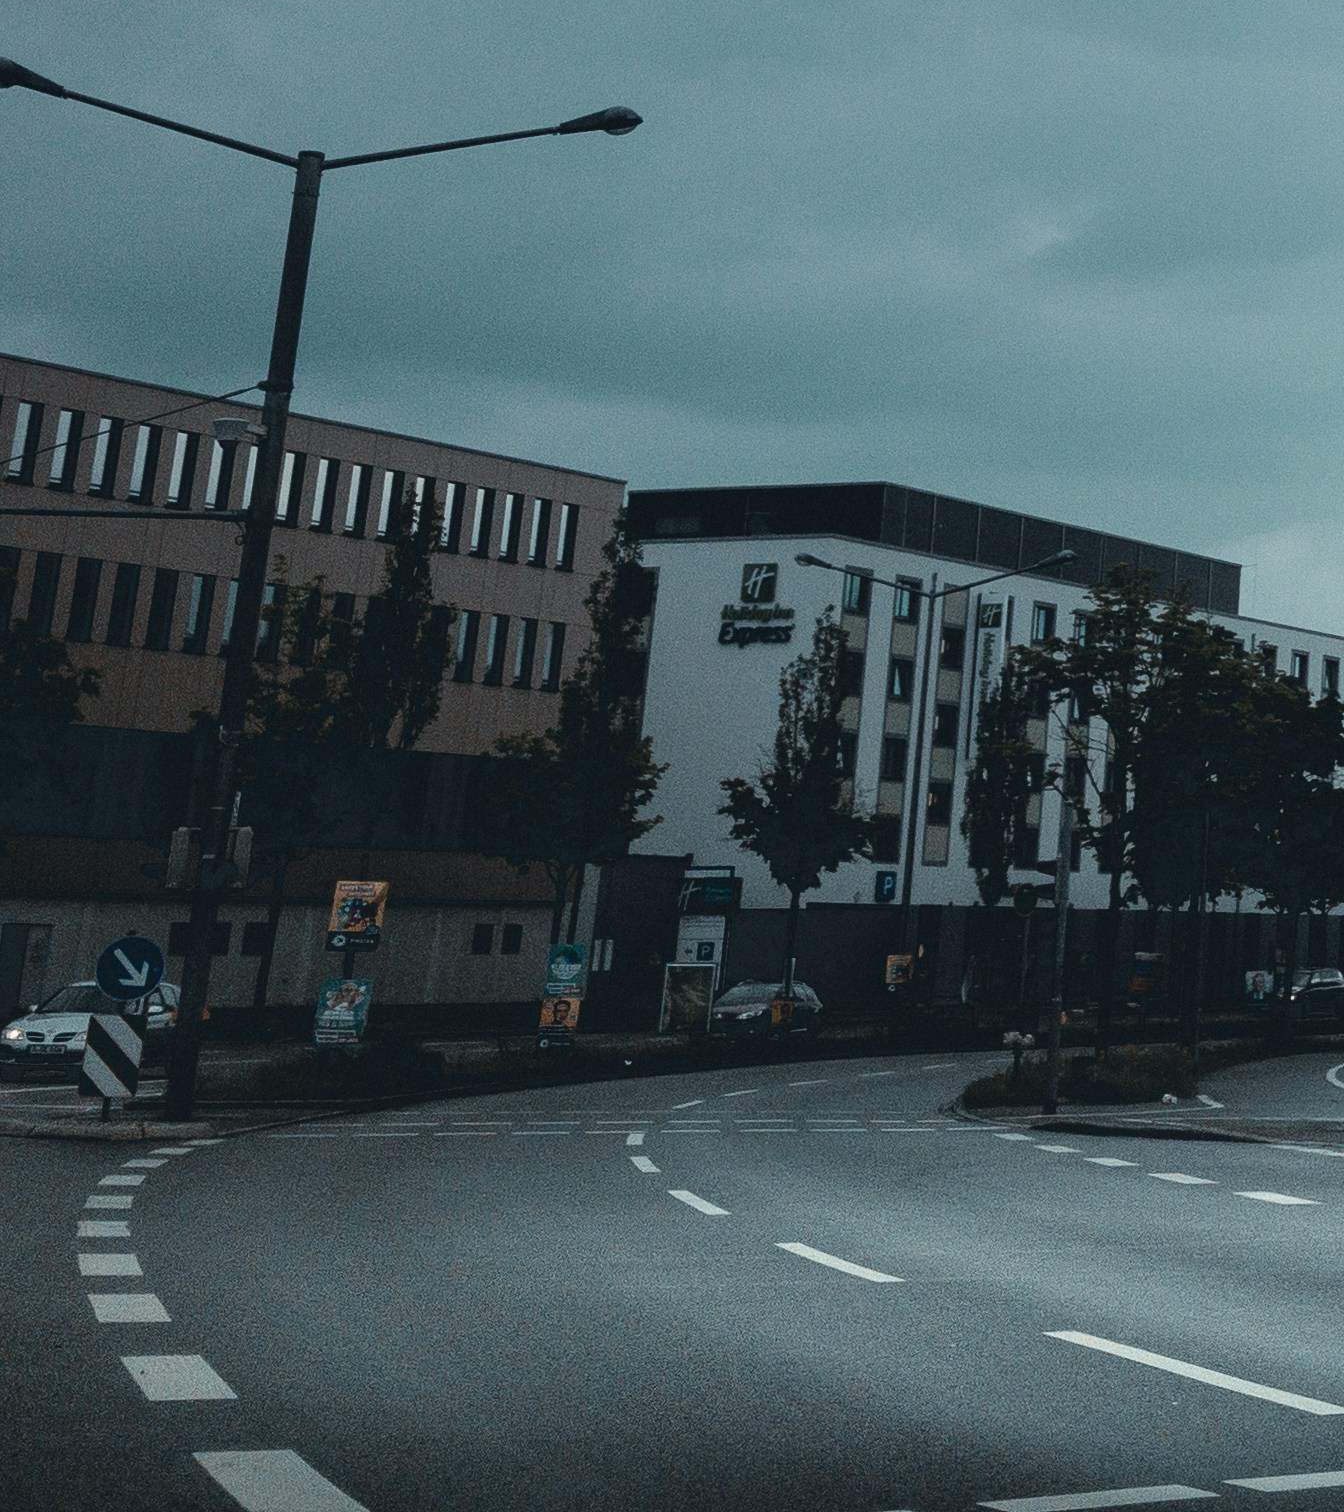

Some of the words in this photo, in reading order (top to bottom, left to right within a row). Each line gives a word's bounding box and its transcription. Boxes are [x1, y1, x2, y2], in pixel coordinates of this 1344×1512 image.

[721, 605, 771, 623] Holiday
[773, 603, 795, 619] Inn
[718, 621, 796, 649] Express
